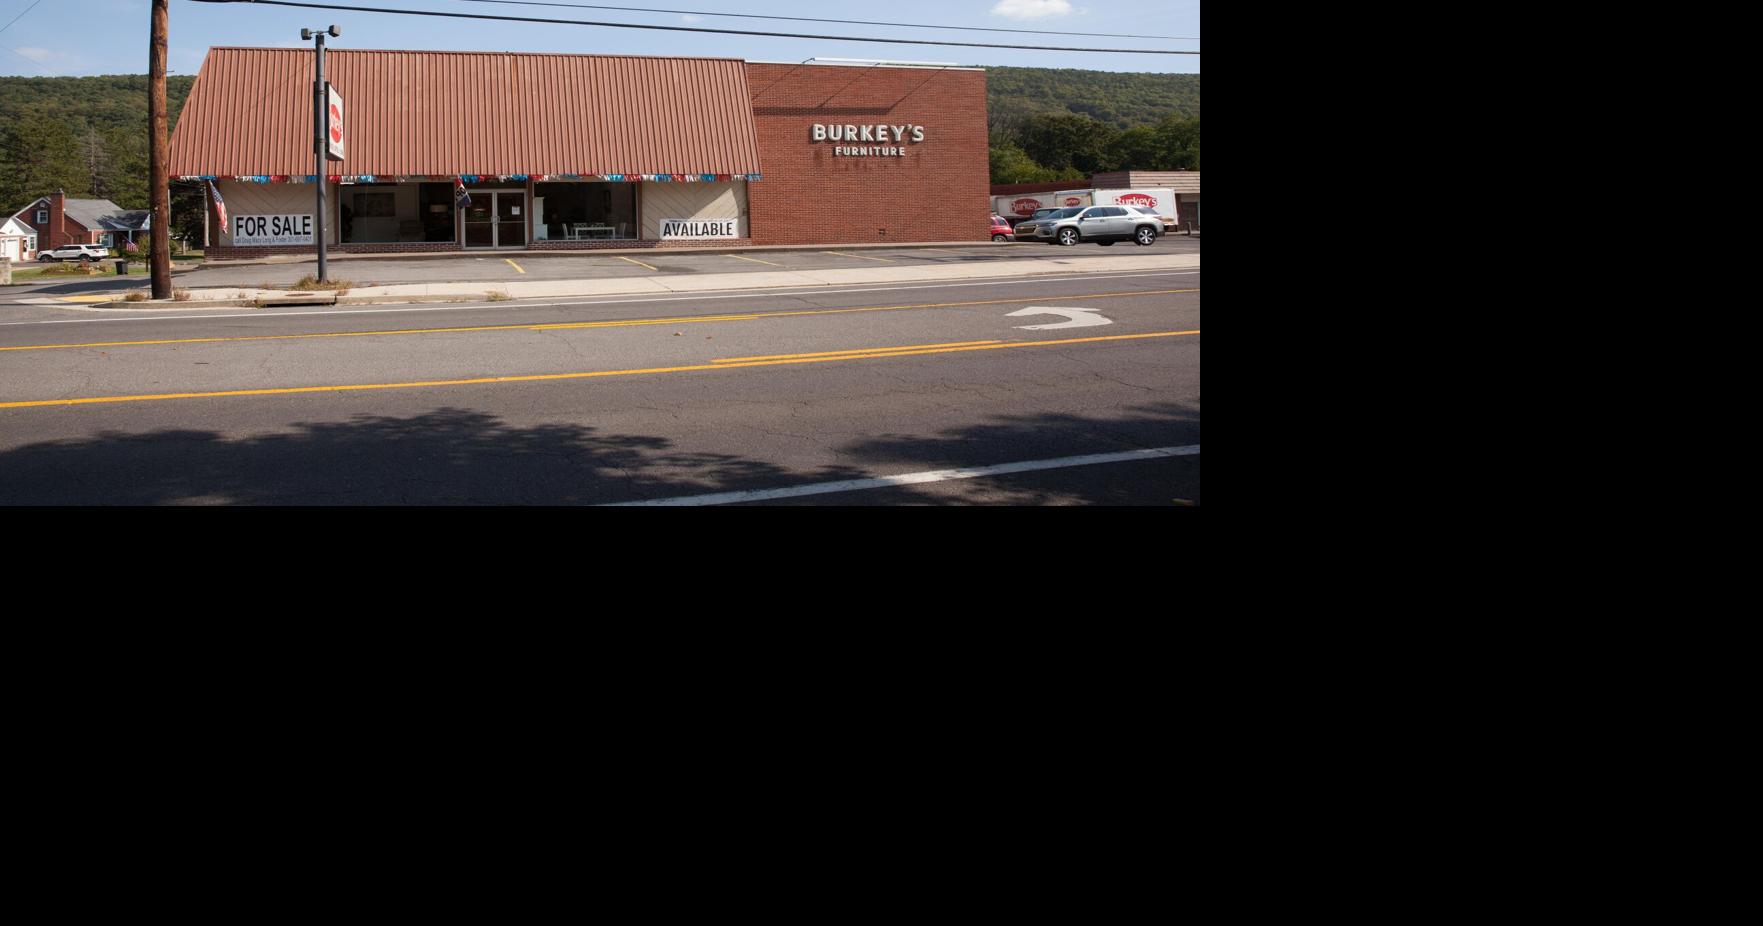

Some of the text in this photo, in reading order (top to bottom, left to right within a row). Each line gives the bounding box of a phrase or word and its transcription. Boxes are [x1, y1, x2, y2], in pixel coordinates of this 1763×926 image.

[812, 123, 925, 142] BURKEY'S
[835, 146, 906, 156] FURNITURE
[236, 216, 311, 236] FOR SALE
[663, 222, 733, 237] AVAILABLE
